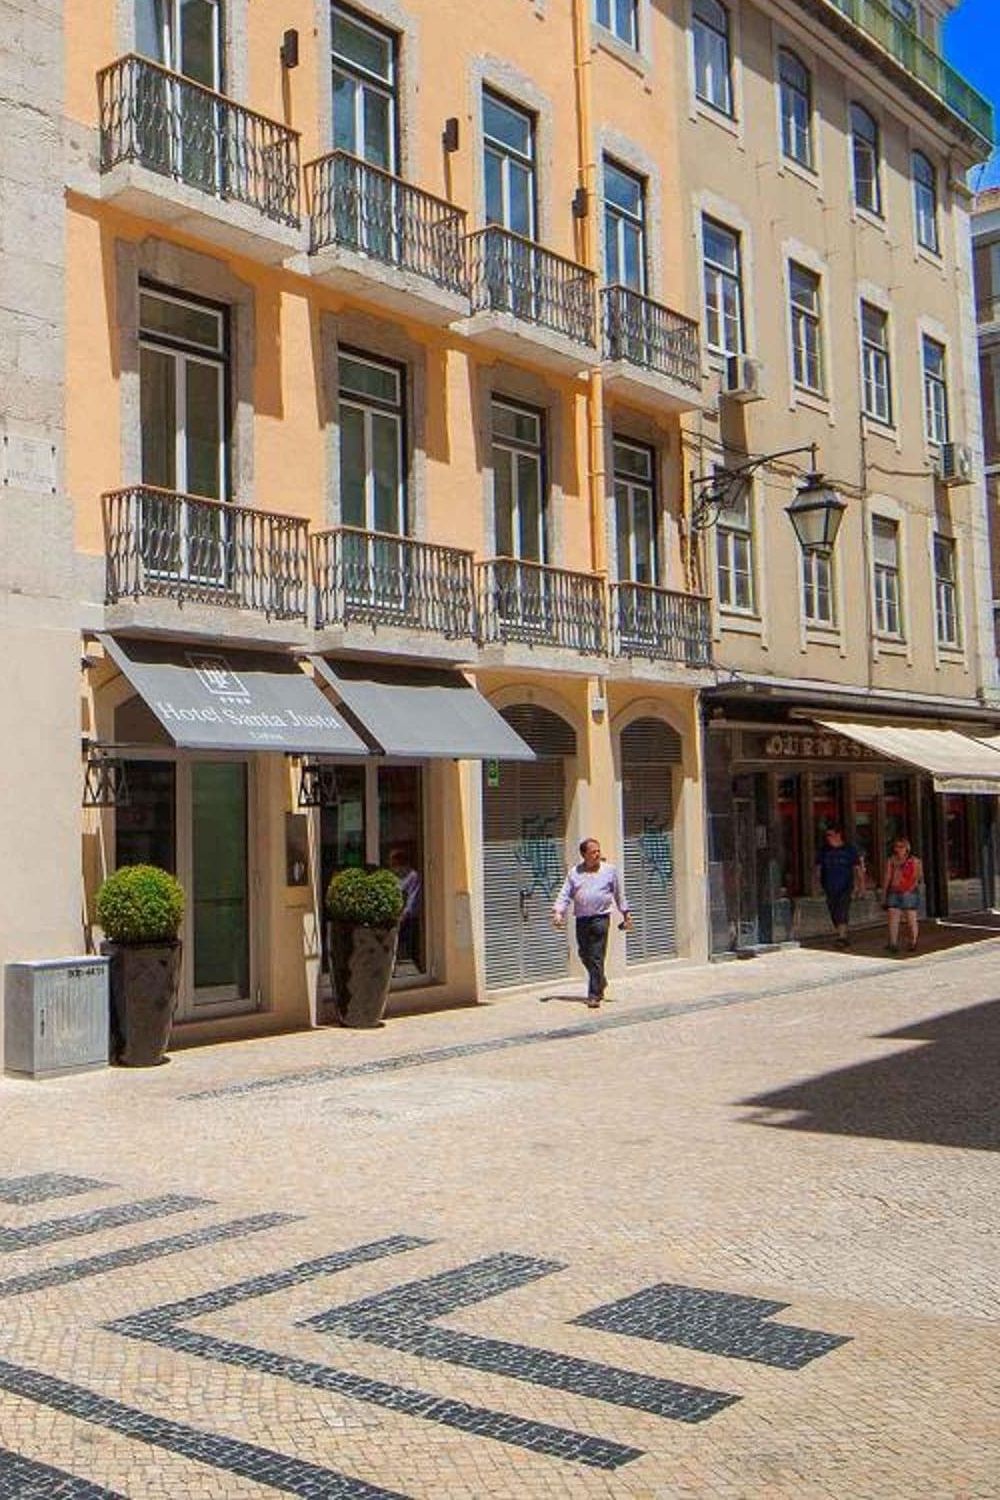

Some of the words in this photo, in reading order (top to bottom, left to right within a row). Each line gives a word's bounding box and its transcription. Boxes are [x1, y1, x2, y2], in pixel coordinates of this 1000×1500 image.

[158, 702, 223, 724] Hotel
[223, 708, 287, 727] Santa
[285, 709, 342, 729] Justa
